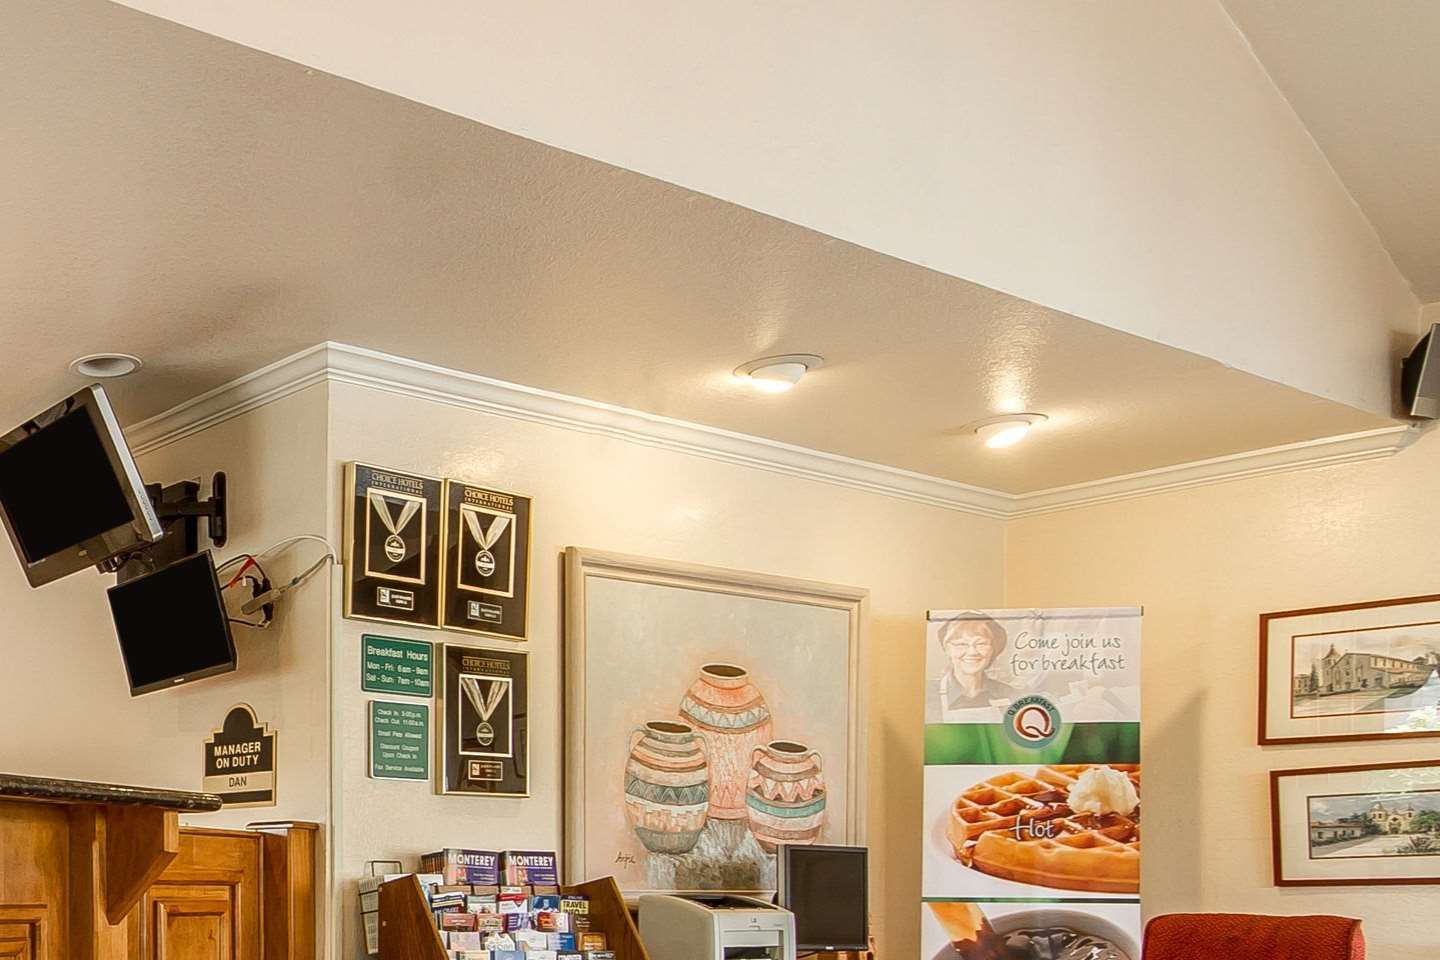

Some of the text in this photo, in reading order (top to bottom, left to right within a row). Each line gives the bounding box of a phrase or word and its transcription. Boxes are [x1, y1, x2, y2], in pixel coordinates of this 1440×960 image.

[372, 472, 397, 485] CHOICE
[464, 490, 514, 506] CHOICE HOTELS
[1014, 631, 1121, 657] Come join us
[368, 645, 428, 661] Breakfast Hours
[1009, 651, 1126, 677] for breakfast
[1015, 706, 1056, 739] Q
[214, 742, 261, 756] MANAGER
[216, 754, 259, 769] ON DUTY
[229, 776, 247, 787] DAN
[1009, 814, 1055, 841] Hot
[449, 854, 496, 867] MONTEREY
[509, 855, 554, 867] MONTEREY
[563, 901, 587, 909] TRAVEL
